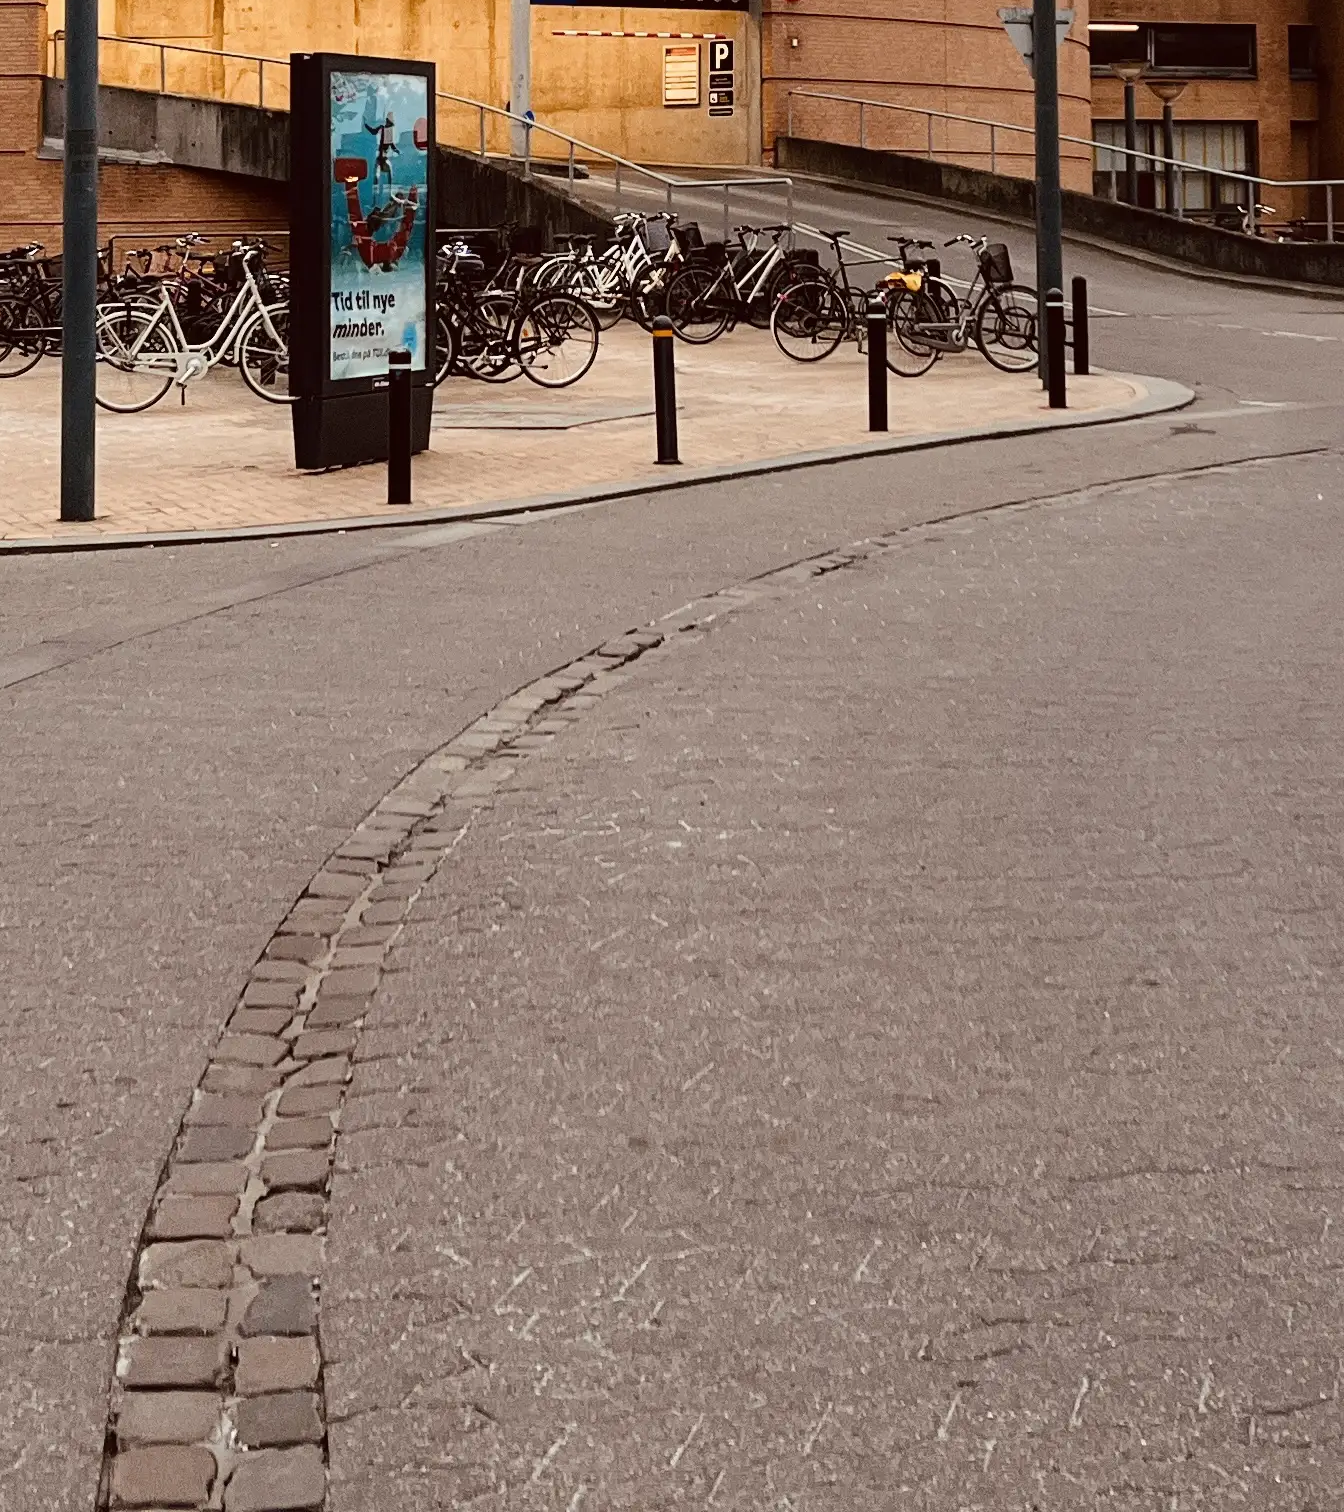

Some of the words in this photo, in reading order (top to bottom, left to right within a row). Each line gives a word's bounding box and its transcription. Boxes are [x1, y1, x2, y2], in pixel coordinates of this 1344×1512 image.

[715, 43, 729, 69] P
[331, 290, 353, 311] Tid
[356, 290, 370, 310] til
[373, 292, 395, 314] nye
[332, 317, 384, 338] minder.
